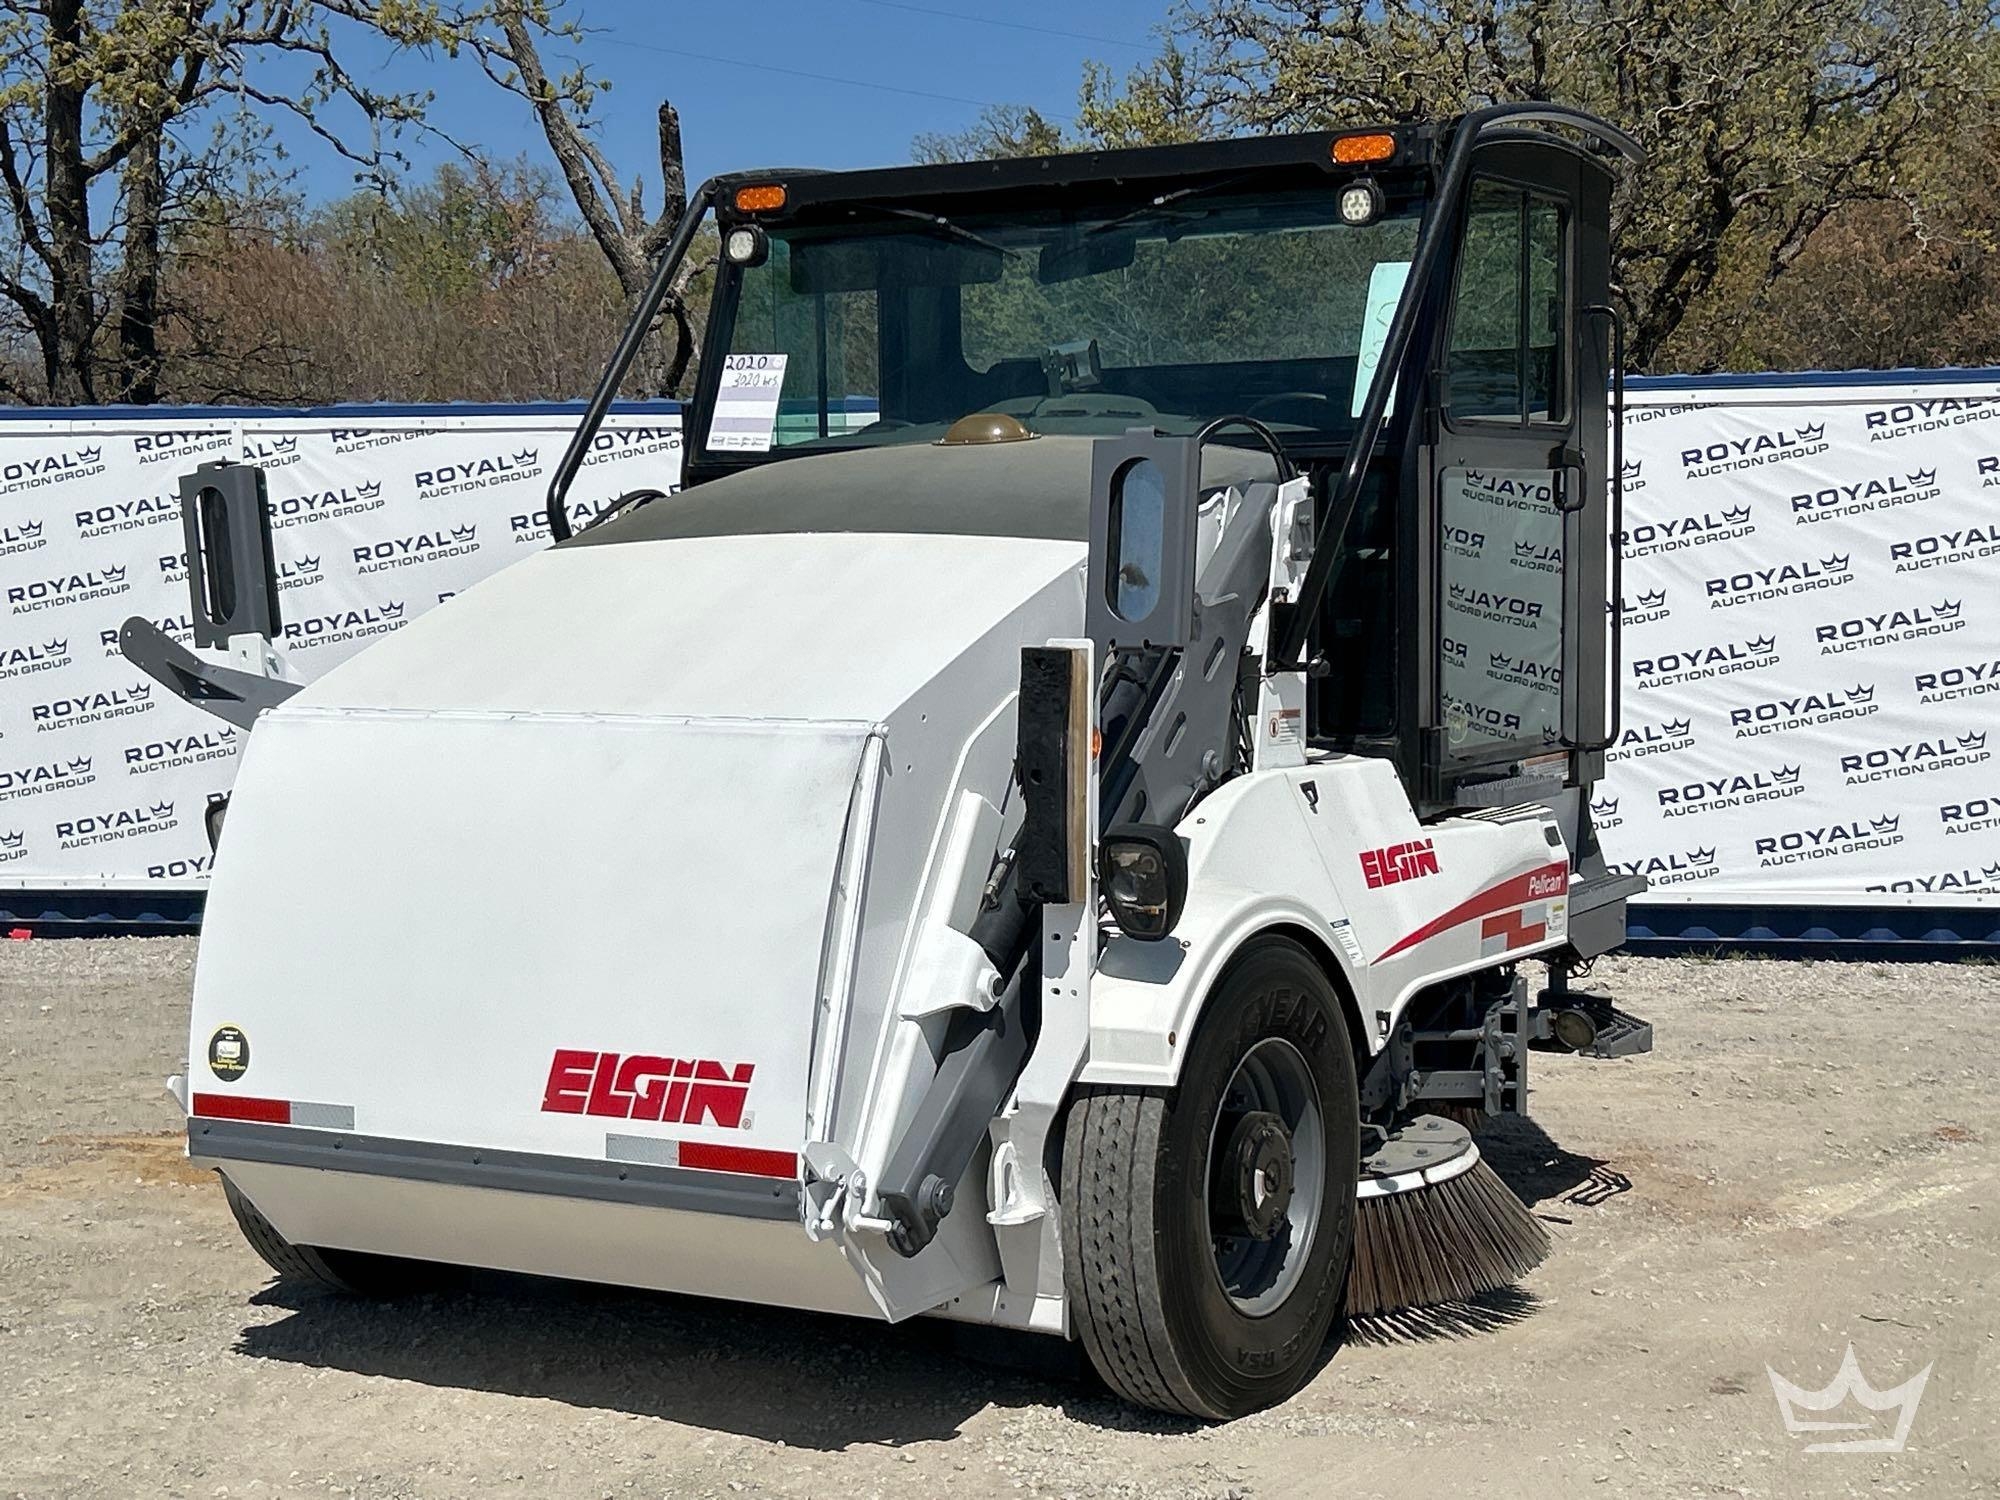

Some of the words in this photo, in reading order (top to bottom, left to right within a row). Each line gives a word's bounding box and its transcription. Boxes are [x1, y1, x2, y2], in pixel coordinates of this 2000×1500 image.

[726, 356, 767, 371] 2020
[731, 372, 760, 388] 3020
[588, 428, 671, 452] OYAL
[1870, 418, 1949, 442] AUCTION
[1953, 408, 2000, 425] GROU
[139, 445, 204, 464] AUCTION
[335, 434, 401, 454] AUCTION
[648, 440, 681, 454] GRO
[1681, 432, 1796, 467] ROYAL
[0, 454, 77, 482] OYAL
[415, 457, 513, 488] ROYAL
[1686, 456, 1764, 479] AUCTION
[1768, 443, 1829, 463] GROUP
[0, 476, 51, 494] UCTION
[54, 465, 105, 482] GROUP
[418, 480, 486, 500] AUCTION
[490, 468, 542, 485] GROUP
[1791, 476, 1907, 512] ROYAL
[76, 496, 170, 527] ROYAL
[333, 500, 385, 517] GROUP
[1796, 501, 1874, 525] AUCTION
[1878, 488, 1941, 508] GROUP
[80, 519, 144, 539] AUCTION
[148, 511, 182, 525] GRO
[1694, 526, 1755, 545] GROUP
[353, 532, 451, 563] ROYAL
[358, 554, 424, 575] AUCTION
[427, 543, 480, 561] GROUP
[1895, 549, 1974, 573] AUCTION
[8, 572, 102, 603] ROYAL
[1706, 562, 1820, 597] ROYAL
[1710, 586, 1788, 609] AUCTION
[1792, 574, 1854, 594] GROUP
[12, 595, 77, 614] AUCTION
[80, 583, 131, 601] GROUP
[284, 608, 379, 639] ROYAL
[1815, 608, 1932, 642] ROYAL
[1820, 632, 1899, 655] AUCTION
[1903, 620, 1966, 640] GROUP
[288, 631, 353, 651] AUCTION
[21, 657, 71, 674] GROUP
[1632, 643, 1747, 677] ROYAL
[1637, 668, 1715, 690] AUCTION
[1718, 655, 1780, 675] GROUP
[32, 690, 127, 720] ROYAL
[37, 713, 101, 732] AUCTION
[104, 702, 155, 718] GROUP
[1730, 692, 1845, 726] ROYAL
[1735, 716, 1813, 739] AUCTION
[1817, 705, 1879, 724] GROUP
[124, 733, 220, 763] ROYAL
[129, 756, 193, 775] AUCTION
[196, 747, 237, 761] GROU
[1635, 738, 1695, 757] GROUP
[1841, 739, 1957, 773] ROYAL
[0, 764, 68, 788] OYAL
[1846, 764, 1924, 786] AUCTION
[1928, 752, 1991, 771] GROUP
[0, 786, 42, 801] CTION
[45, 775, 95, 791] GROUP
[1658, 773, 1772, 805] ROYAL
[1663, 797, 1740, 818] AUCTION
[1743, 785, 1805, 804] GROUP
[56, 808, 151, 838] ROYAL
[61, 831, 124, 849] AUCTION
[128, 819, 178, 836] GROUP
[1755, 822, 1870, 855] ROYAL
[1945, 818, 2000, 835] AUCTI
[0, 849, 28, 861] OUP
[148, 854, 215, 878] ROY
[1358, 838, 1439, 889] ELGIN
[1760, 847, 1838, 868] AUCTION
[1842, 835, 1904, 853] GROUP
[1528, 874, 1562, 897] Pelican
[1660, 867, 1719, 885] GROUP
[541, 1049, 755, 1129] ELGIN
